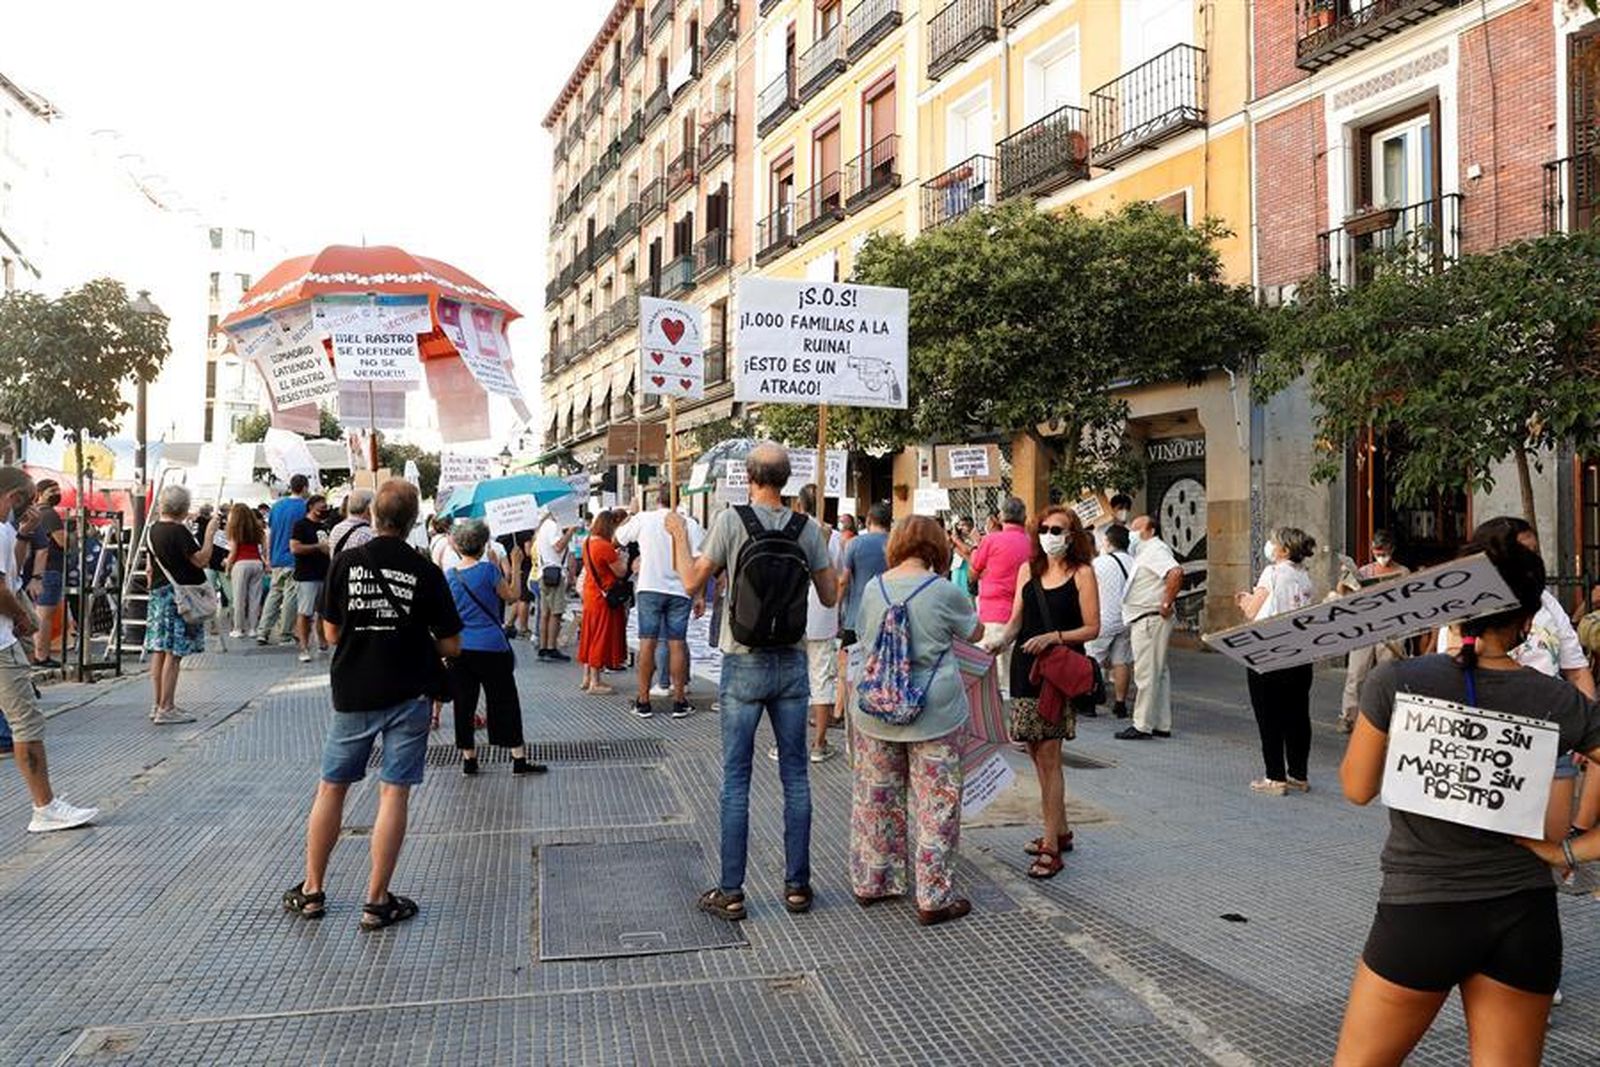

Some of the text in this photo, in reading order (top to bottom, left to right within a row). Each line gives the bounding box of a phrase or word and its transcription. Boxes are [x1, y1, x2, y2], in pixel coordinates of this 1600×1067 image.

[798, 287, 857, 309] ¡S.O.S!
[740, 312, 890, 335] ¡1.000 FAMILIAS A LA
[364, 333, 415, 344] RASTRO
[803, 338, 851, 354] RUINA!
[337, 347, 415, 356] SE DEFIENDE
[272, 359, 315, 378] LATIENDO
[360, 359, 396, 367] NO SE
[744, 357, 836, 375] ¡ESTO ES UN
[280, 371, 325, 390] EL RASTRO
[760, 379, 821, 396] ATRACO!
[349, 565, 364, 581] NO
[348, 581, 363, 596] NO
[1222, 569, 1473, 651] EL RASTRO
[1243, 592, 1503, 666] ES CULTURA
[1429, 738, 1513, 768] RASTRO
[1424, 776, 1506, 810] ROSTRO
